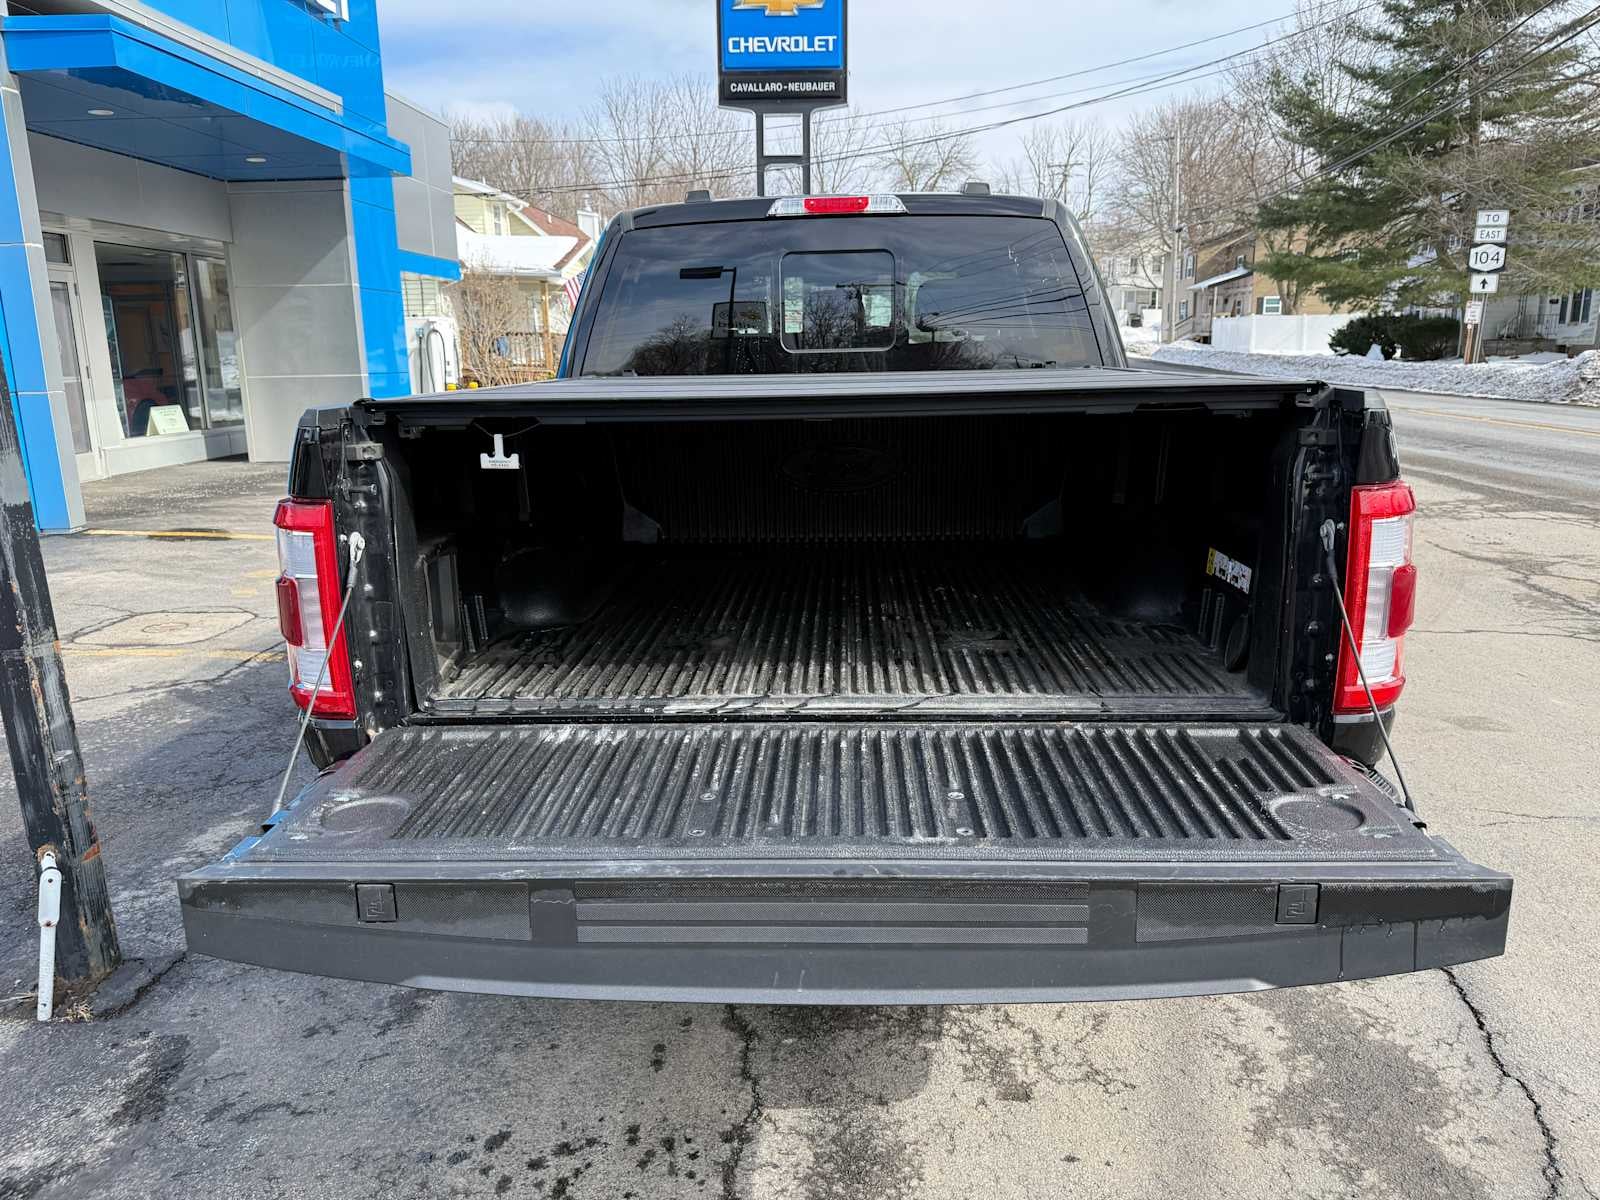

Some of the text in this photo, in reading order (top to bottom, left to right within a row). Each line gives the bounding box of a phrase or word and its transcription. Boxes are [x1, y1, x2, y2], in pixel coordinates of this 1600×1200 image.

[728, 36, 837, 53] CHEVROLET
[1486, 214, 1500, 223] TO
[1480, 230, 1501, 239] EAST
[1474, 251, 1500, 265] 104
